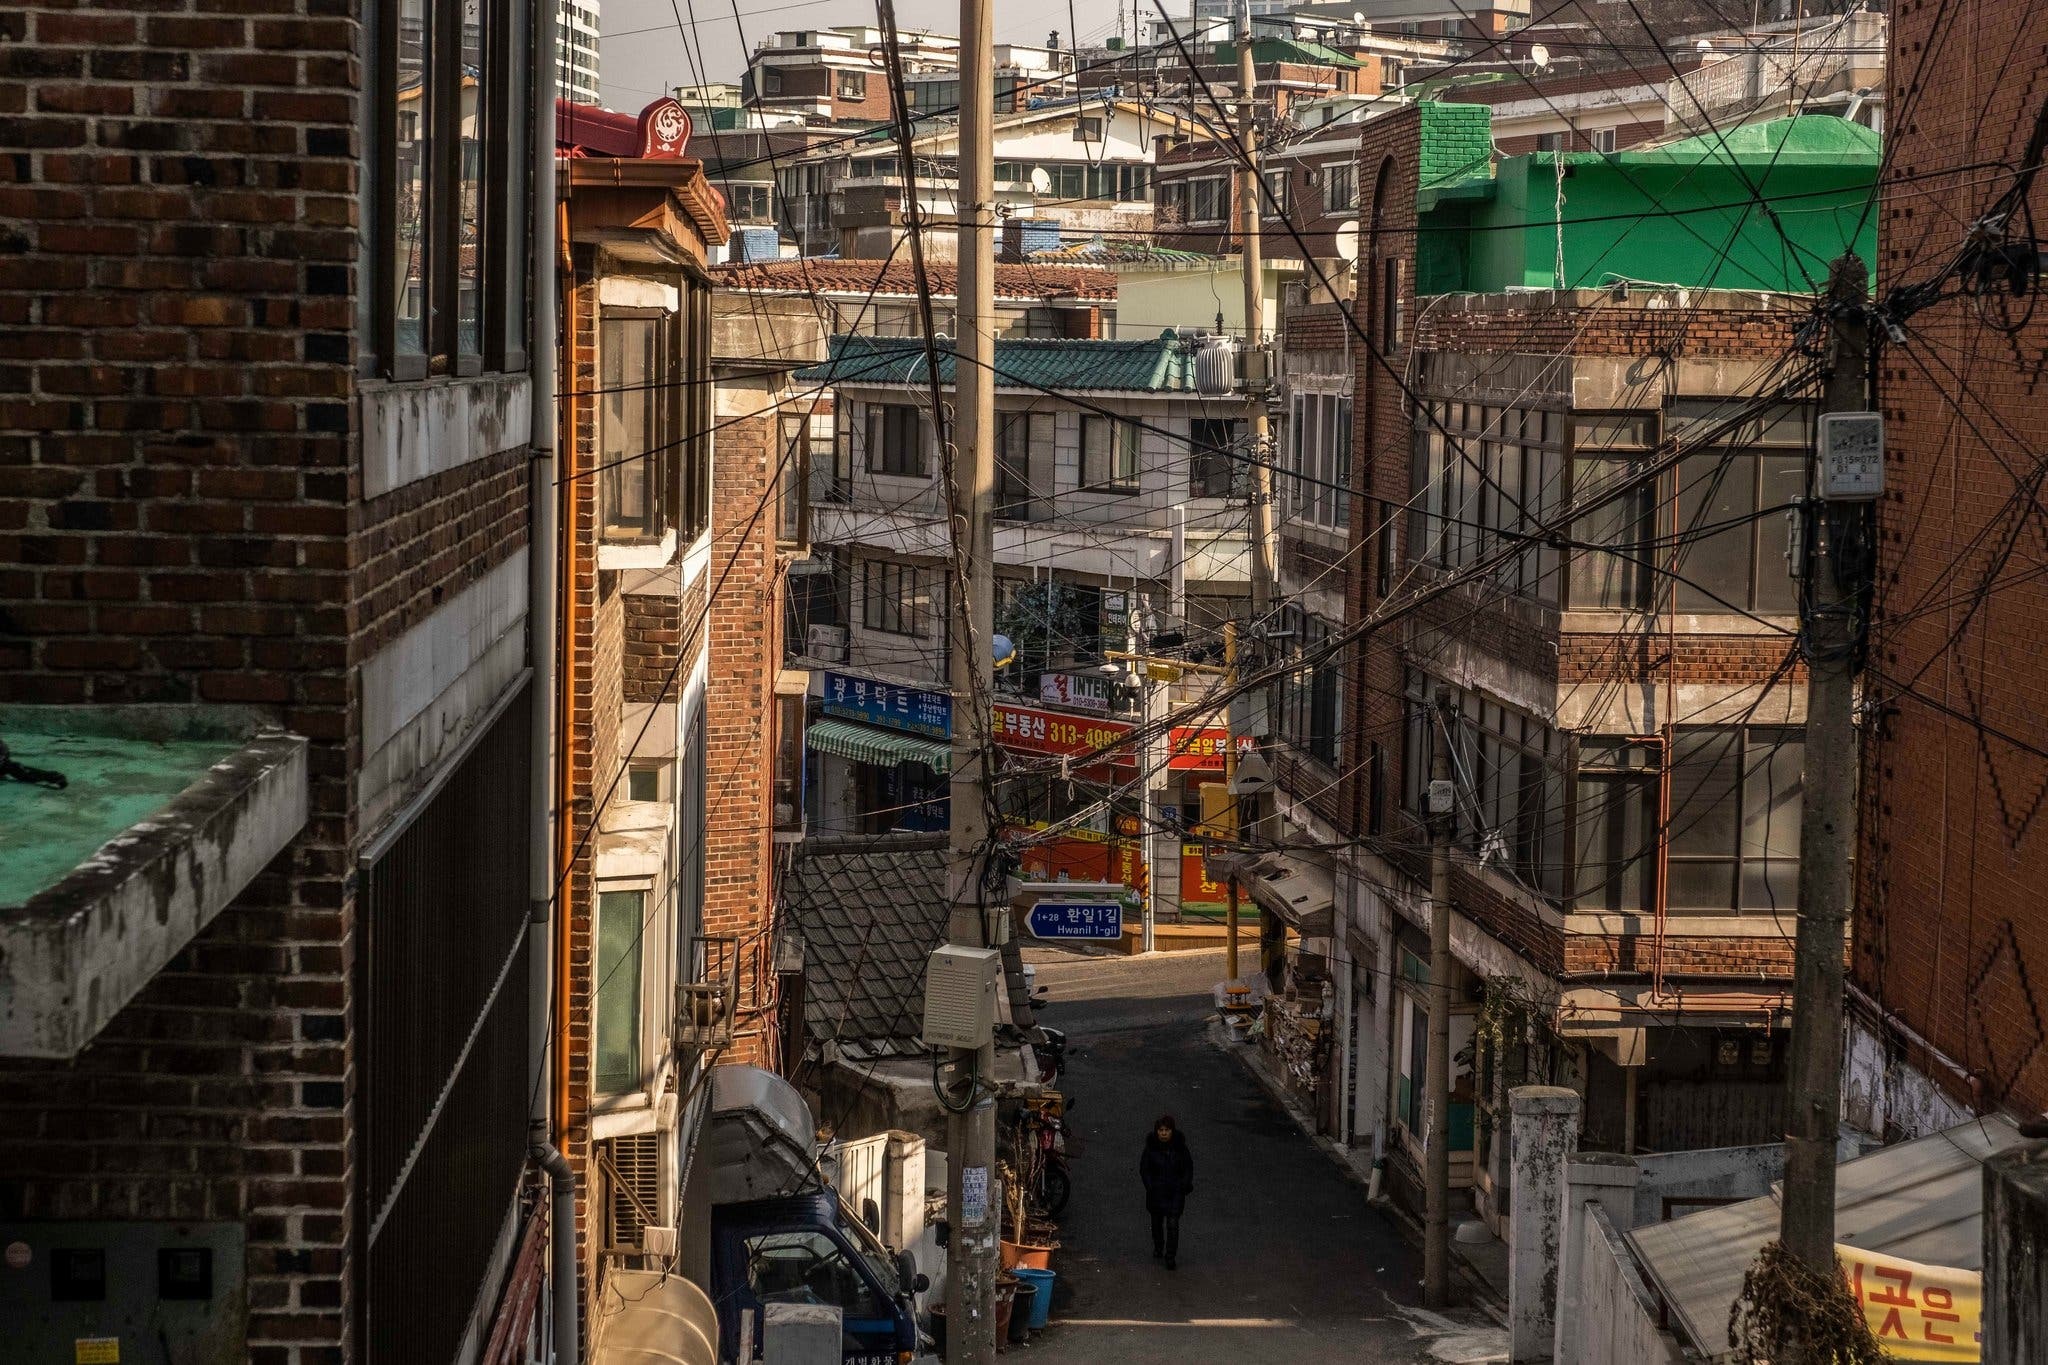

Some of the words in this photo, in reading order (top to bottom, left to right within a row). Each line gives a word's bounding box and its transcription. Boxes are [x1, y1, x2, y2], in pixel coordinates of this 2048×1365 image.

[1067, 908, 1117, 924] 환일1길
[1057, 924, 1092, 935] Hwanil
[1094, 925, 1117, 937] 1-gil
